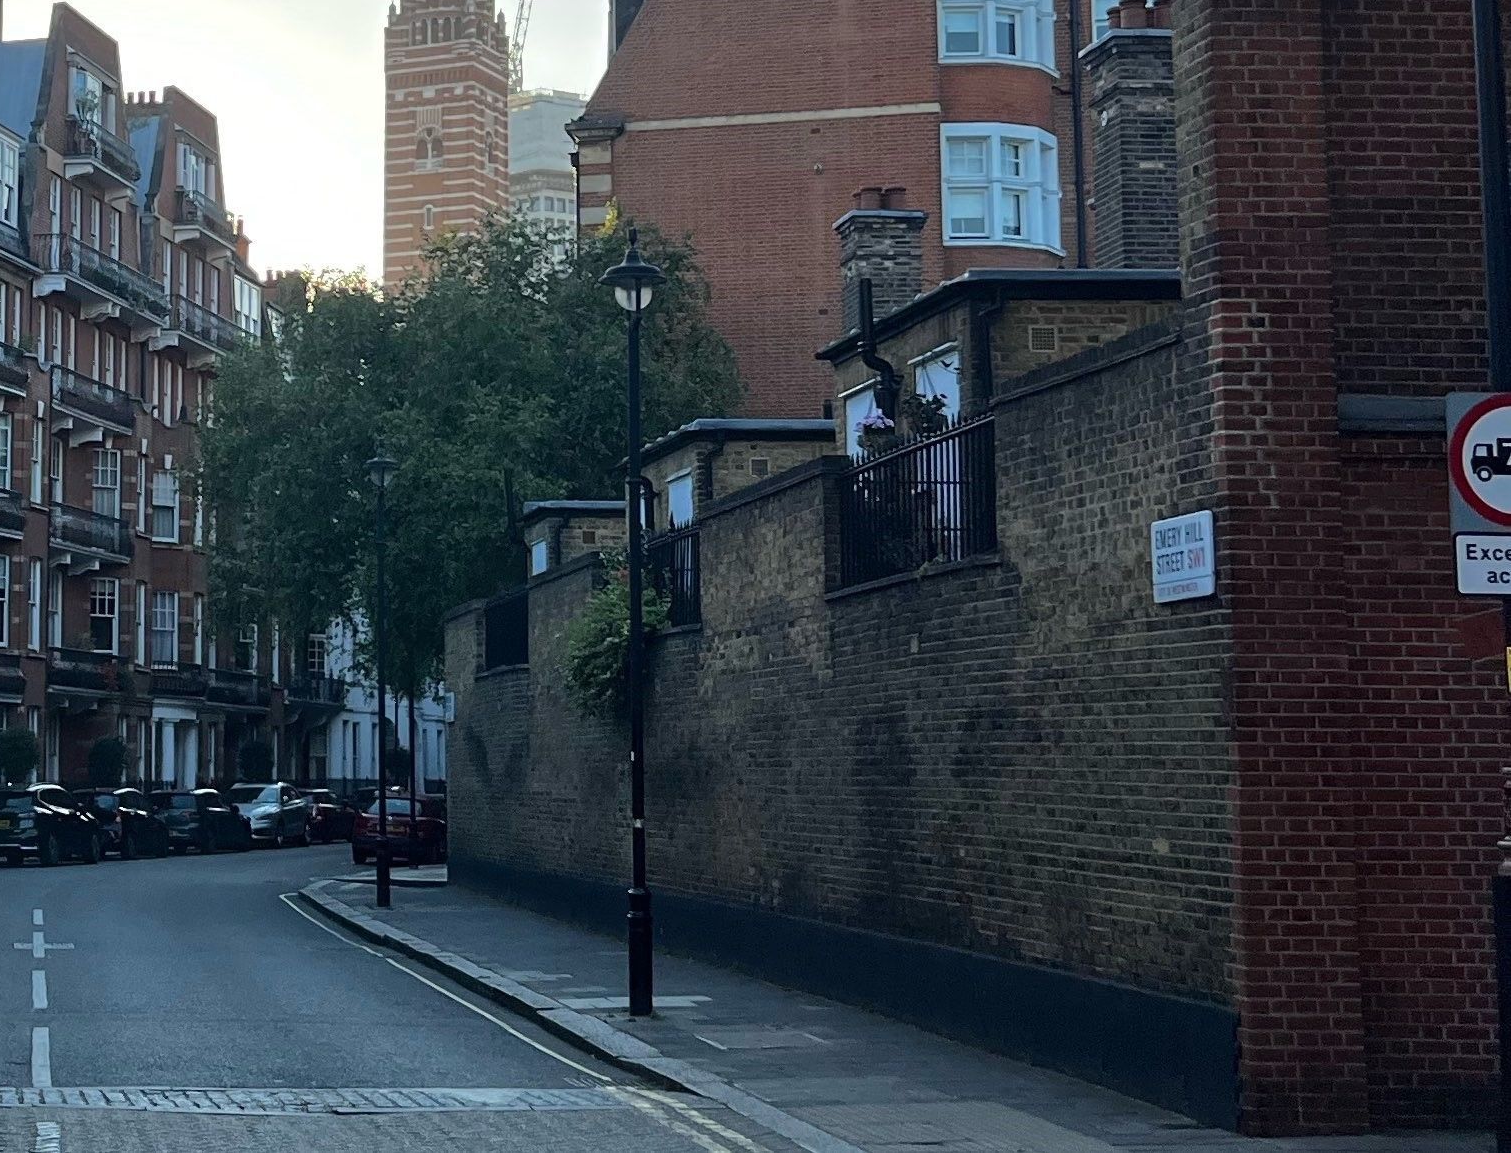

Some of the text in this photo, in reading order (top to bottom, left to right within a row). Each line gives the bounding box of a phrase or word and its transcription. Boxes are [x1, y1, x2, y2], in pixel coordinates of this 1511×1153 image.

[1155, 521, 1204, 550] EMERY HILL
[1156, 547, 1205, 575] STREET SW1
